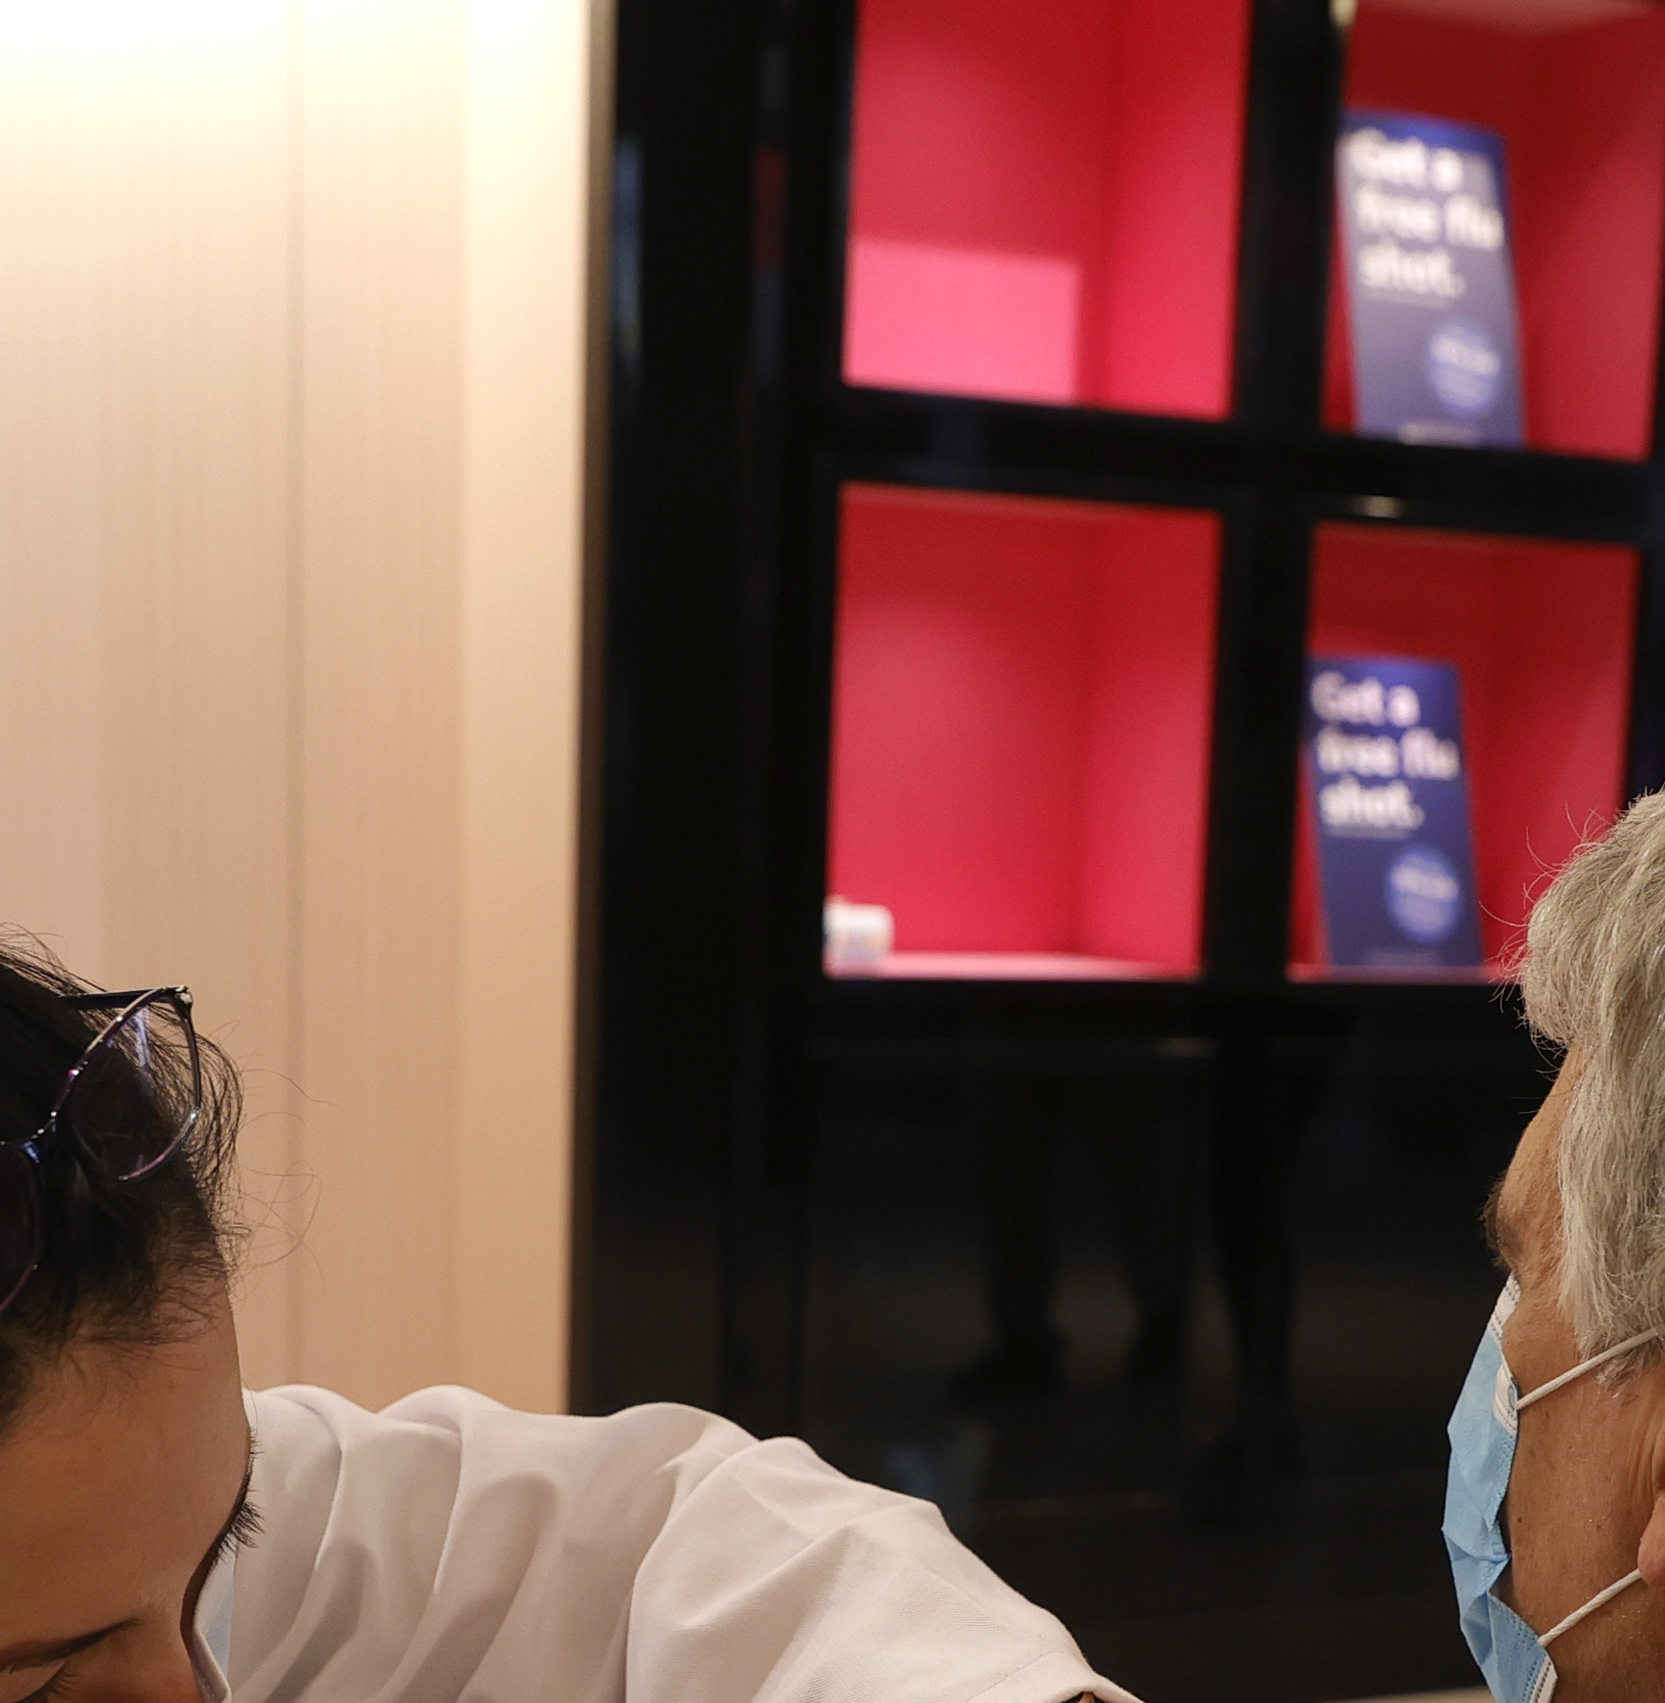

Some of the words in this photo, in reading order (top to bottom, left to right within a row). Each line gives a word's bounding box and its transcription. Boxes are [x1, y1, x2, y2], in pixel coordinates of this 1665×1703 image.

[1346, 128, 1427, 187] Get
[1432, 149, 1463, 191] a
[1356, 185, 1439, 240] free
[1445, 196, 1503, 250] flu
[1358, 241, 1465, 296] shot.
[1311, 672, 1383, 725] Get
[1387, 686, 1420, 727] a
[1317, 724, 1399, 777] free
[1400, 728, 1459, 779] flu
[1320, 776, 1424, 829] shot.
